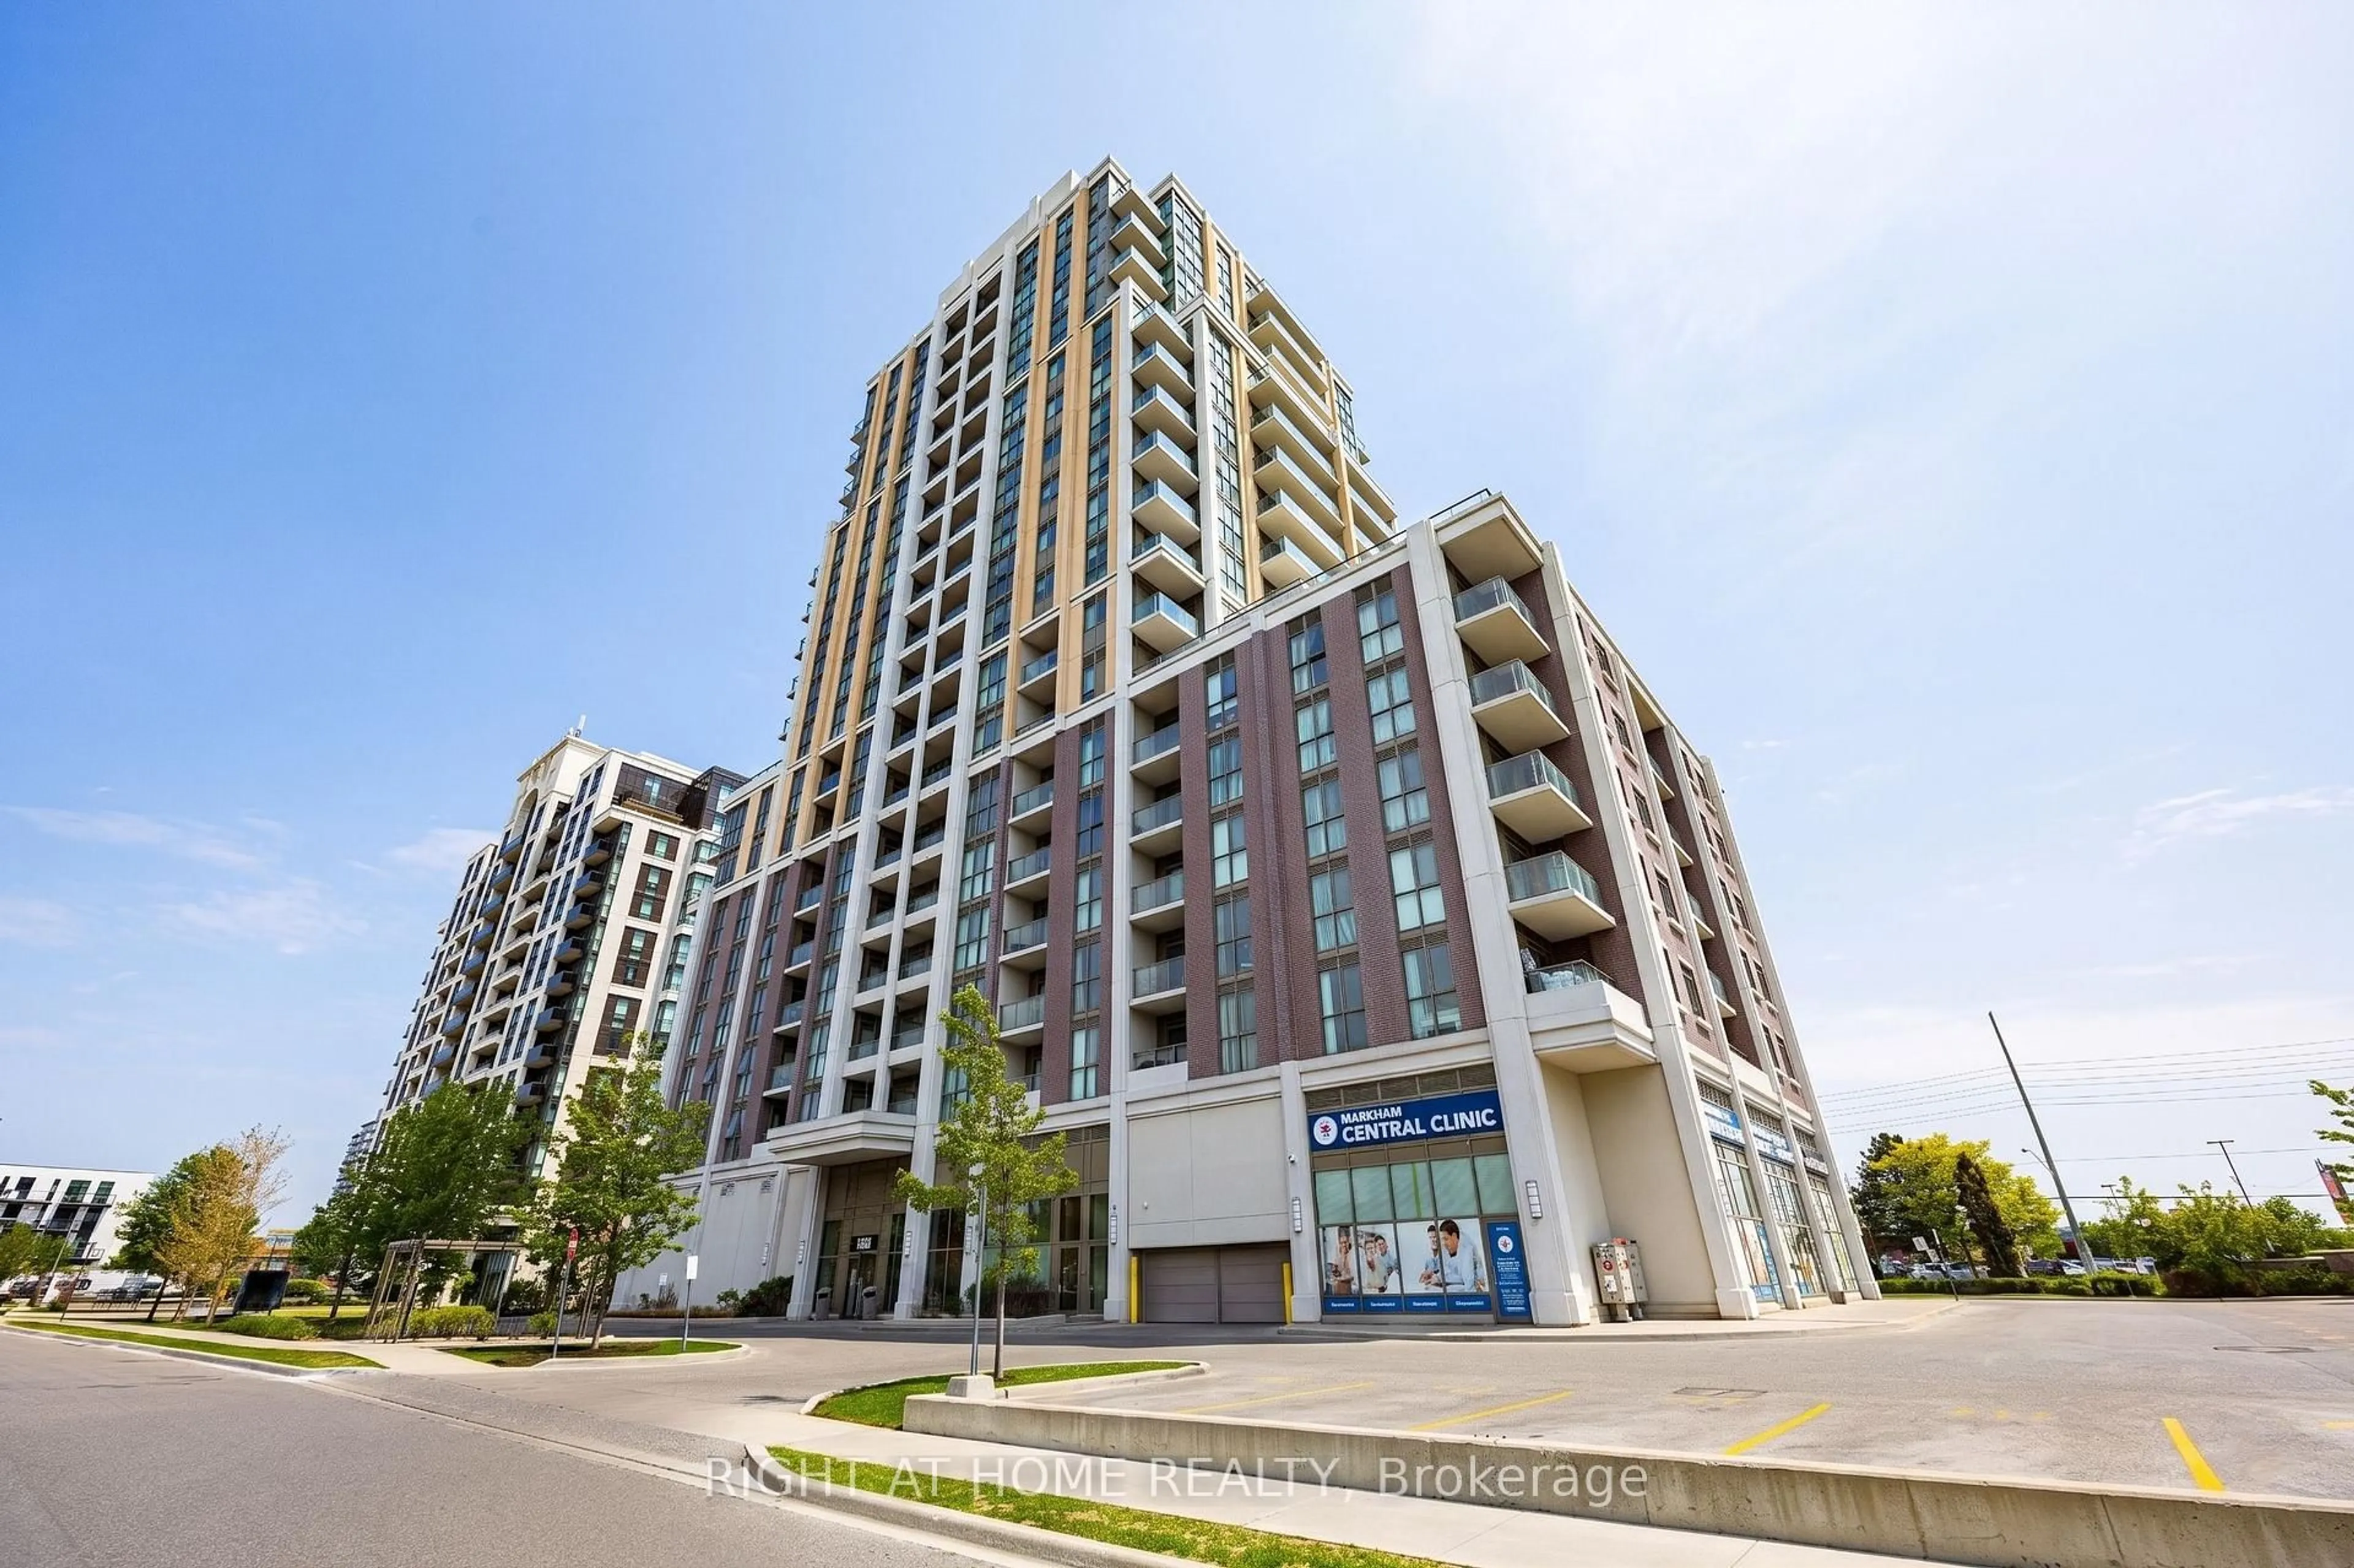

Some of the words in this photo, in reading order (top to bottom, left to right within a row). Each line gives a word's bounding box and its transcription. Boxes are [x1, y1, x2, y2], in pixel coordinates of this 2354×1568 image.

[1341, 1106, 1402, 1124] MARKHAM
[1342, 1118, 1426, 1143] CENTRAL
[1430, 1108, 1497, 1133] CLINIC
